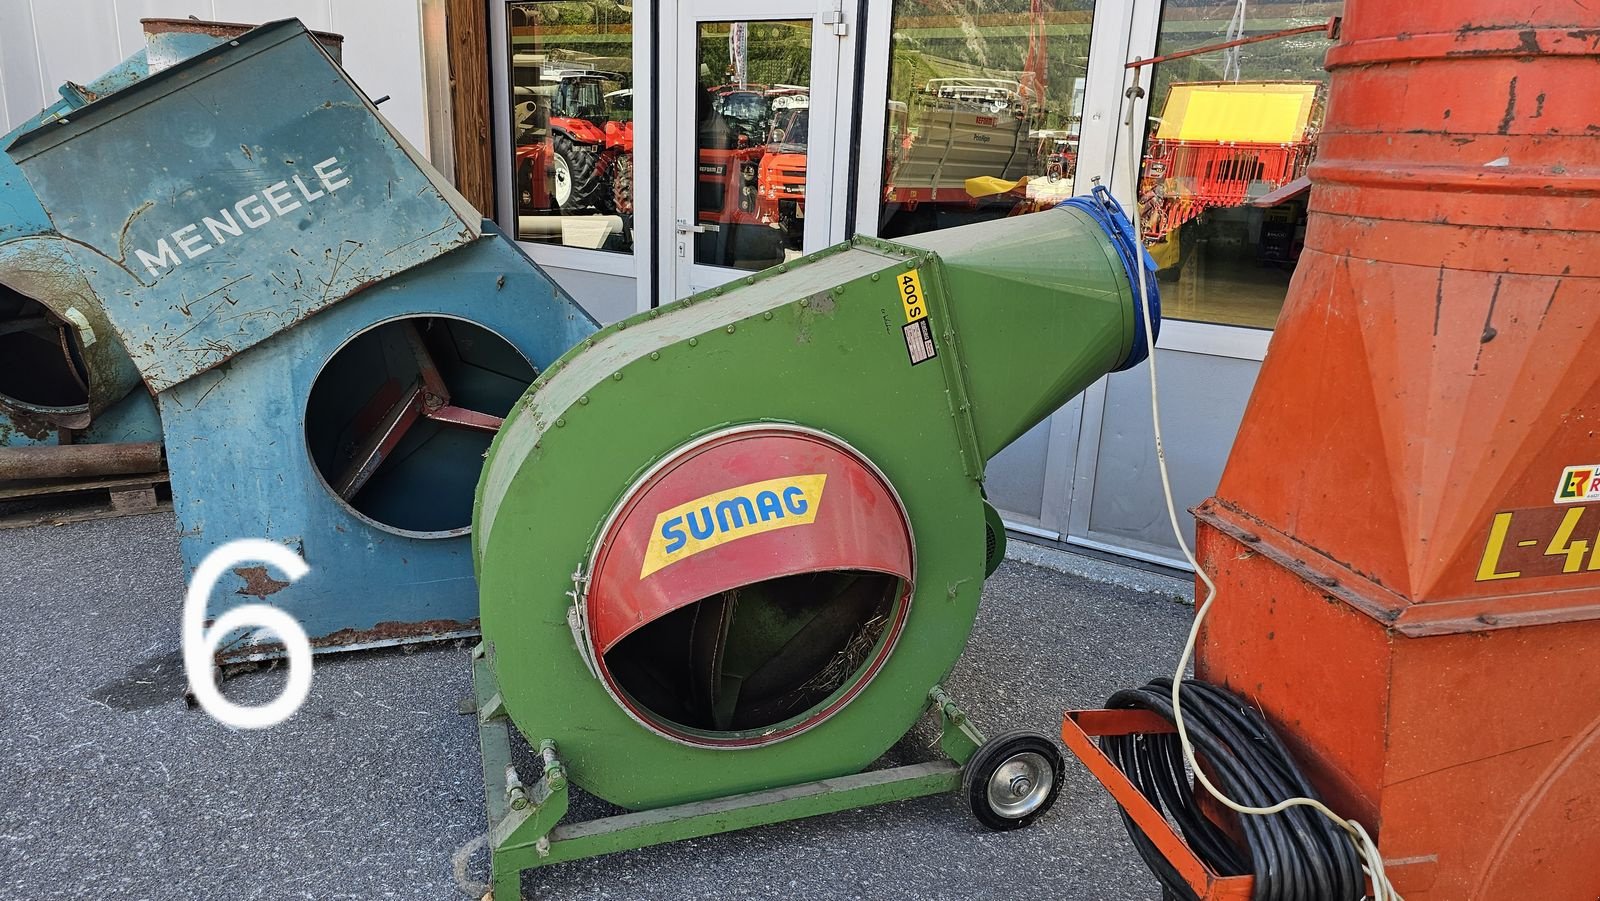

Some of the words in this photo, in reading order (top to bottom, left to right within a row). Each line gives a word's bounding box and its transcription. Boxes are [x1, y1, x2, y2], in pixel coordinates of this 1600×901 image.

[135, 156, 352, 277] MENGELE
[902, 276, 918, 305] 400
[909, 306, 921, 318] S
[661, 486, 808, 554] SUMAG
